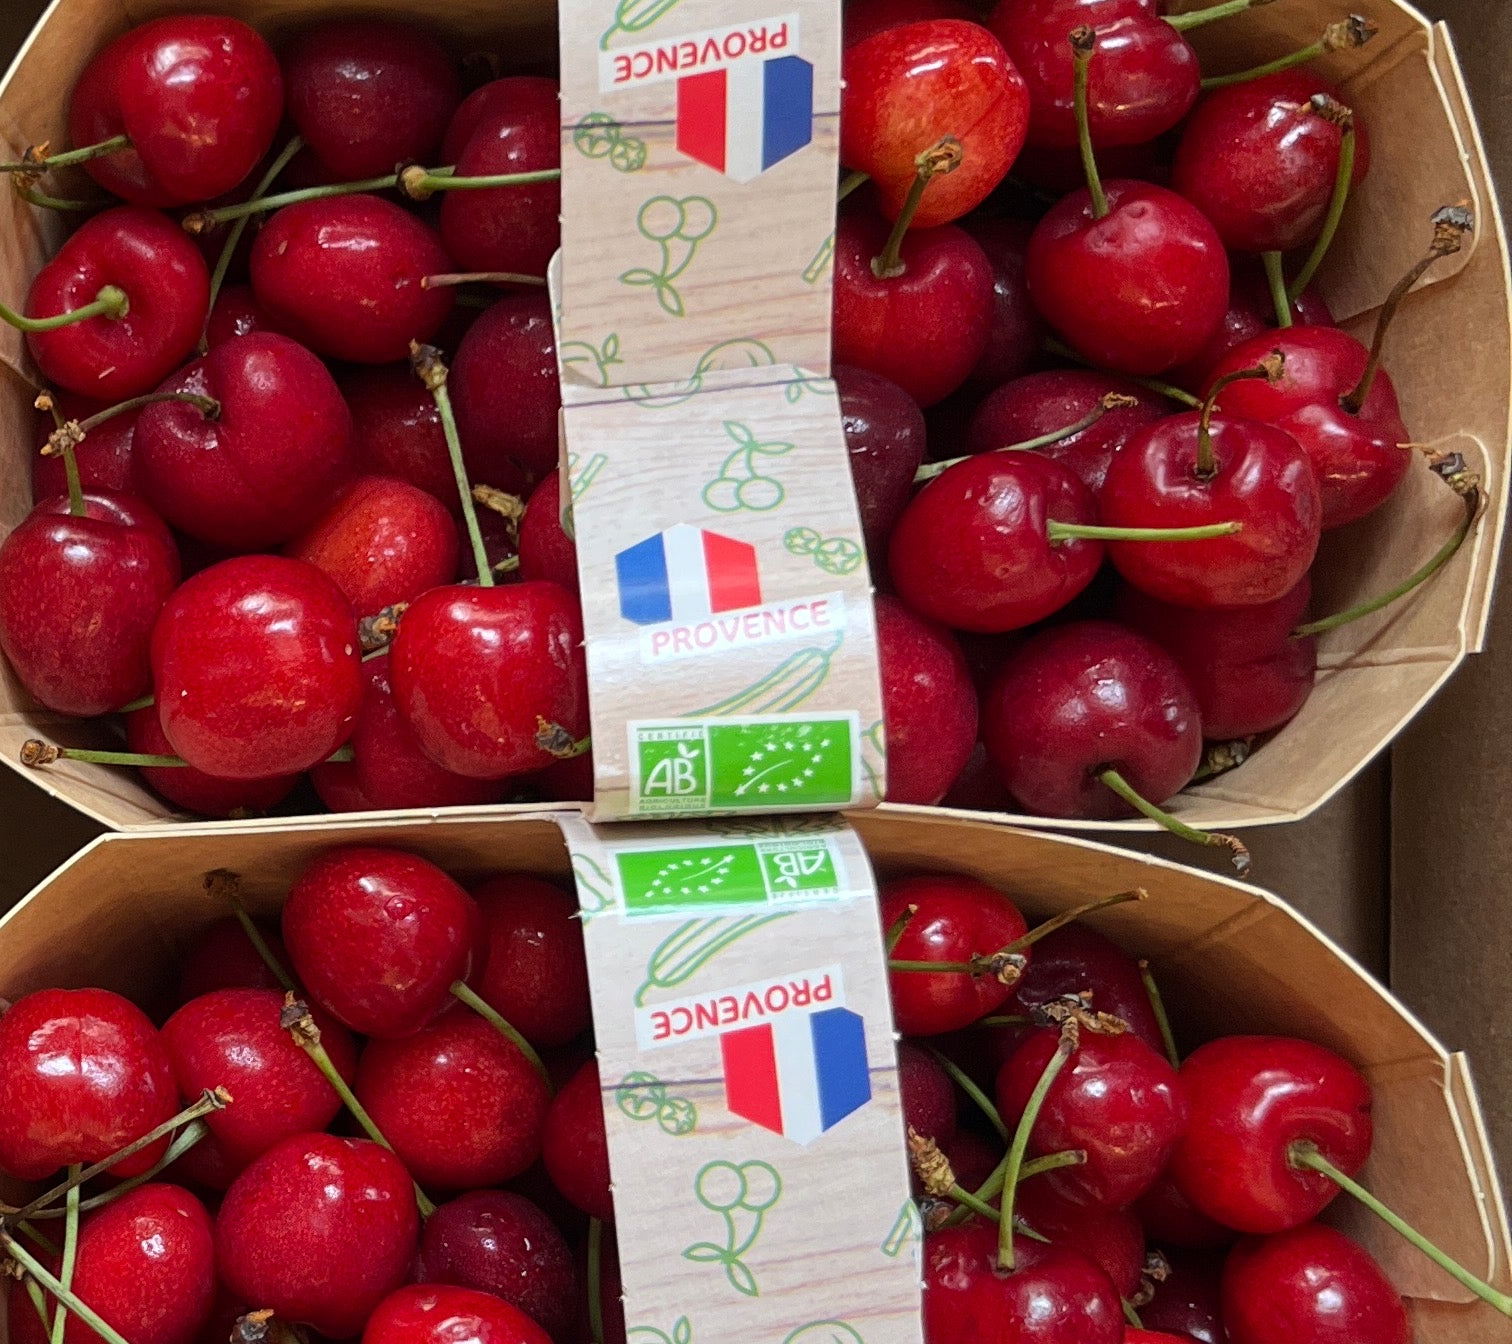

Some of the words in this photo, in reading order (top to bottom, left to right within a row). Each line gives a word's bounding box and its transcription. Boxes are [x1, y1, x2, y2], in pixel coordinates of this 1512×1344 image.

[613, 22, 787, 83] PROVENCE
[651, 599, 831, 656] PROVENCE
[644, 757, 697, 795] AB
[772, 850, 826, 876] AB
[650, 974, 833, 1040] PROVENCE
